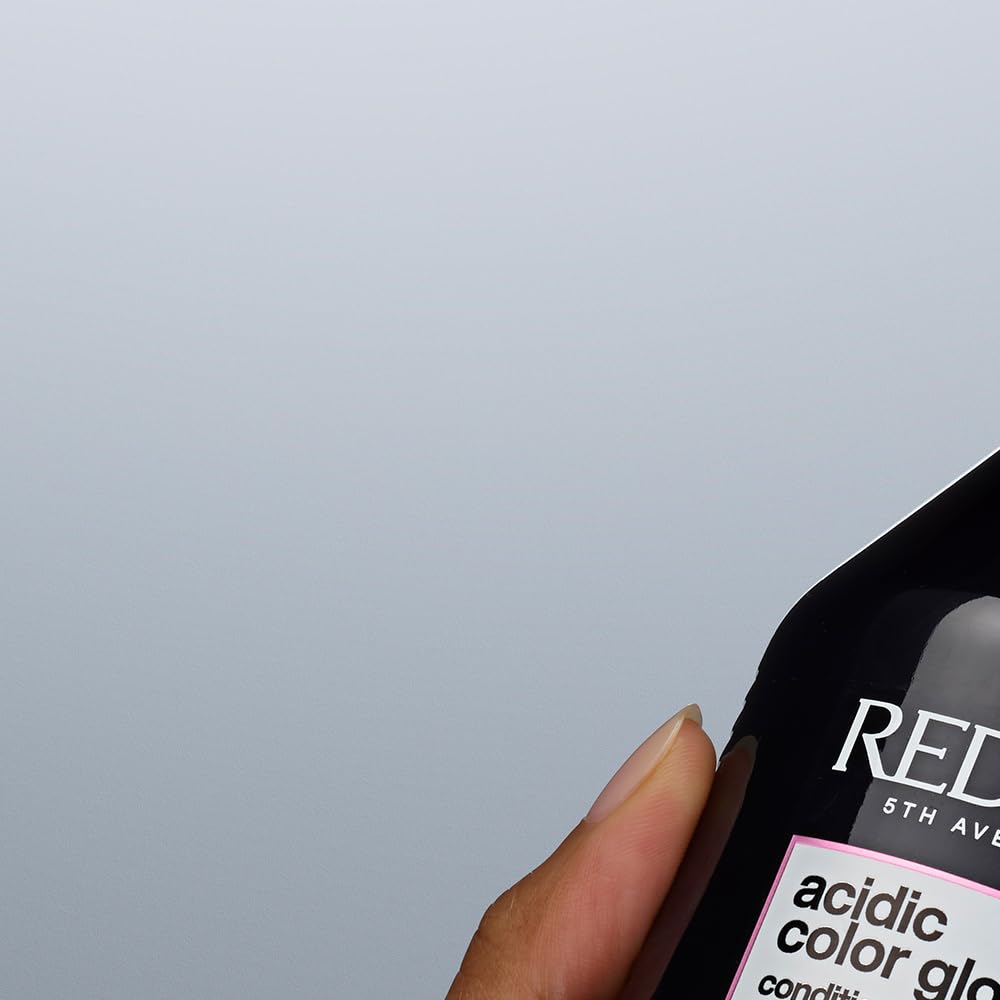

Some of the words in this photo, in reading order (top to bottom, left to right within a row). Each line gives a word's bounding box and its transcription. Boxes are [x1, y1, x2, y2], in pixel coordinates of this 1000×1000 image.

[882, 797, 938, 824] 5TH
[793, 874, 948, 942] acidic
[776, 919, 911, 979] color
